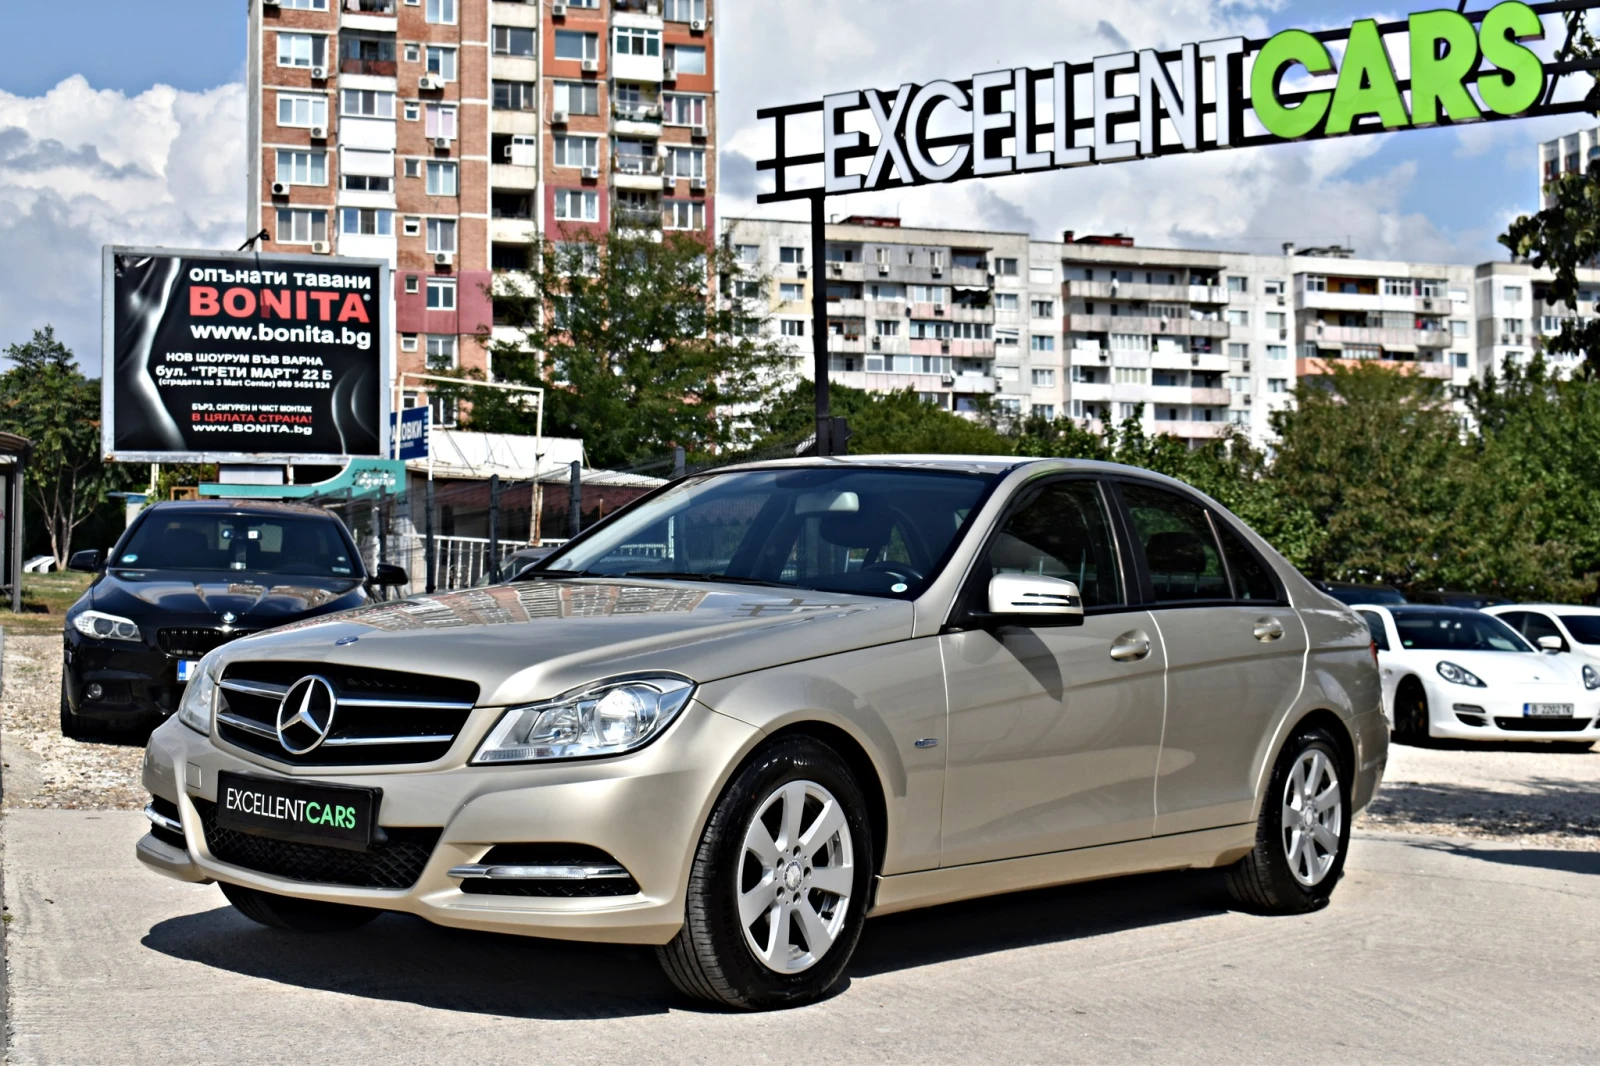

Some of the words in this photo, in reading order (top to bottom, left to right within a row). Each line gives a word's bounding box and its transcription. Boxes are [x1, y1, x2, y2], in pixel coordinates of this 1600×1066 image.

[189, 268, 287, 285] опънати
[293, 272, 371, 289] тавани
[189, 286, 370, 323] BONITA
[190, 322, 371, 350] www.bonita.bg
[166, 352, 193, 362] НОВ
[195, 352, 250, 363] ШОУРУМ
[252, 354, 280, 364] ВЪВ
[282, 355, 323, 366] ВАРНА
[155, 365, 187, 379] бул.
[302, 369, 319, 380] 22
[322, 369, 333, 380] Б
[216, 403, 251, 412] СИГУРЕН
[258, 404, 279, 412] ЧИСТ
[279, 405, 313, 413] МОНТАЖ
[192, 413, 200, 421] В
[204, 413, 256, 423] ЦЯЛАТА
[258, 414, 313, 424] СТРАНА!
[192, 423, 313, 435] www.BONITA.bg
